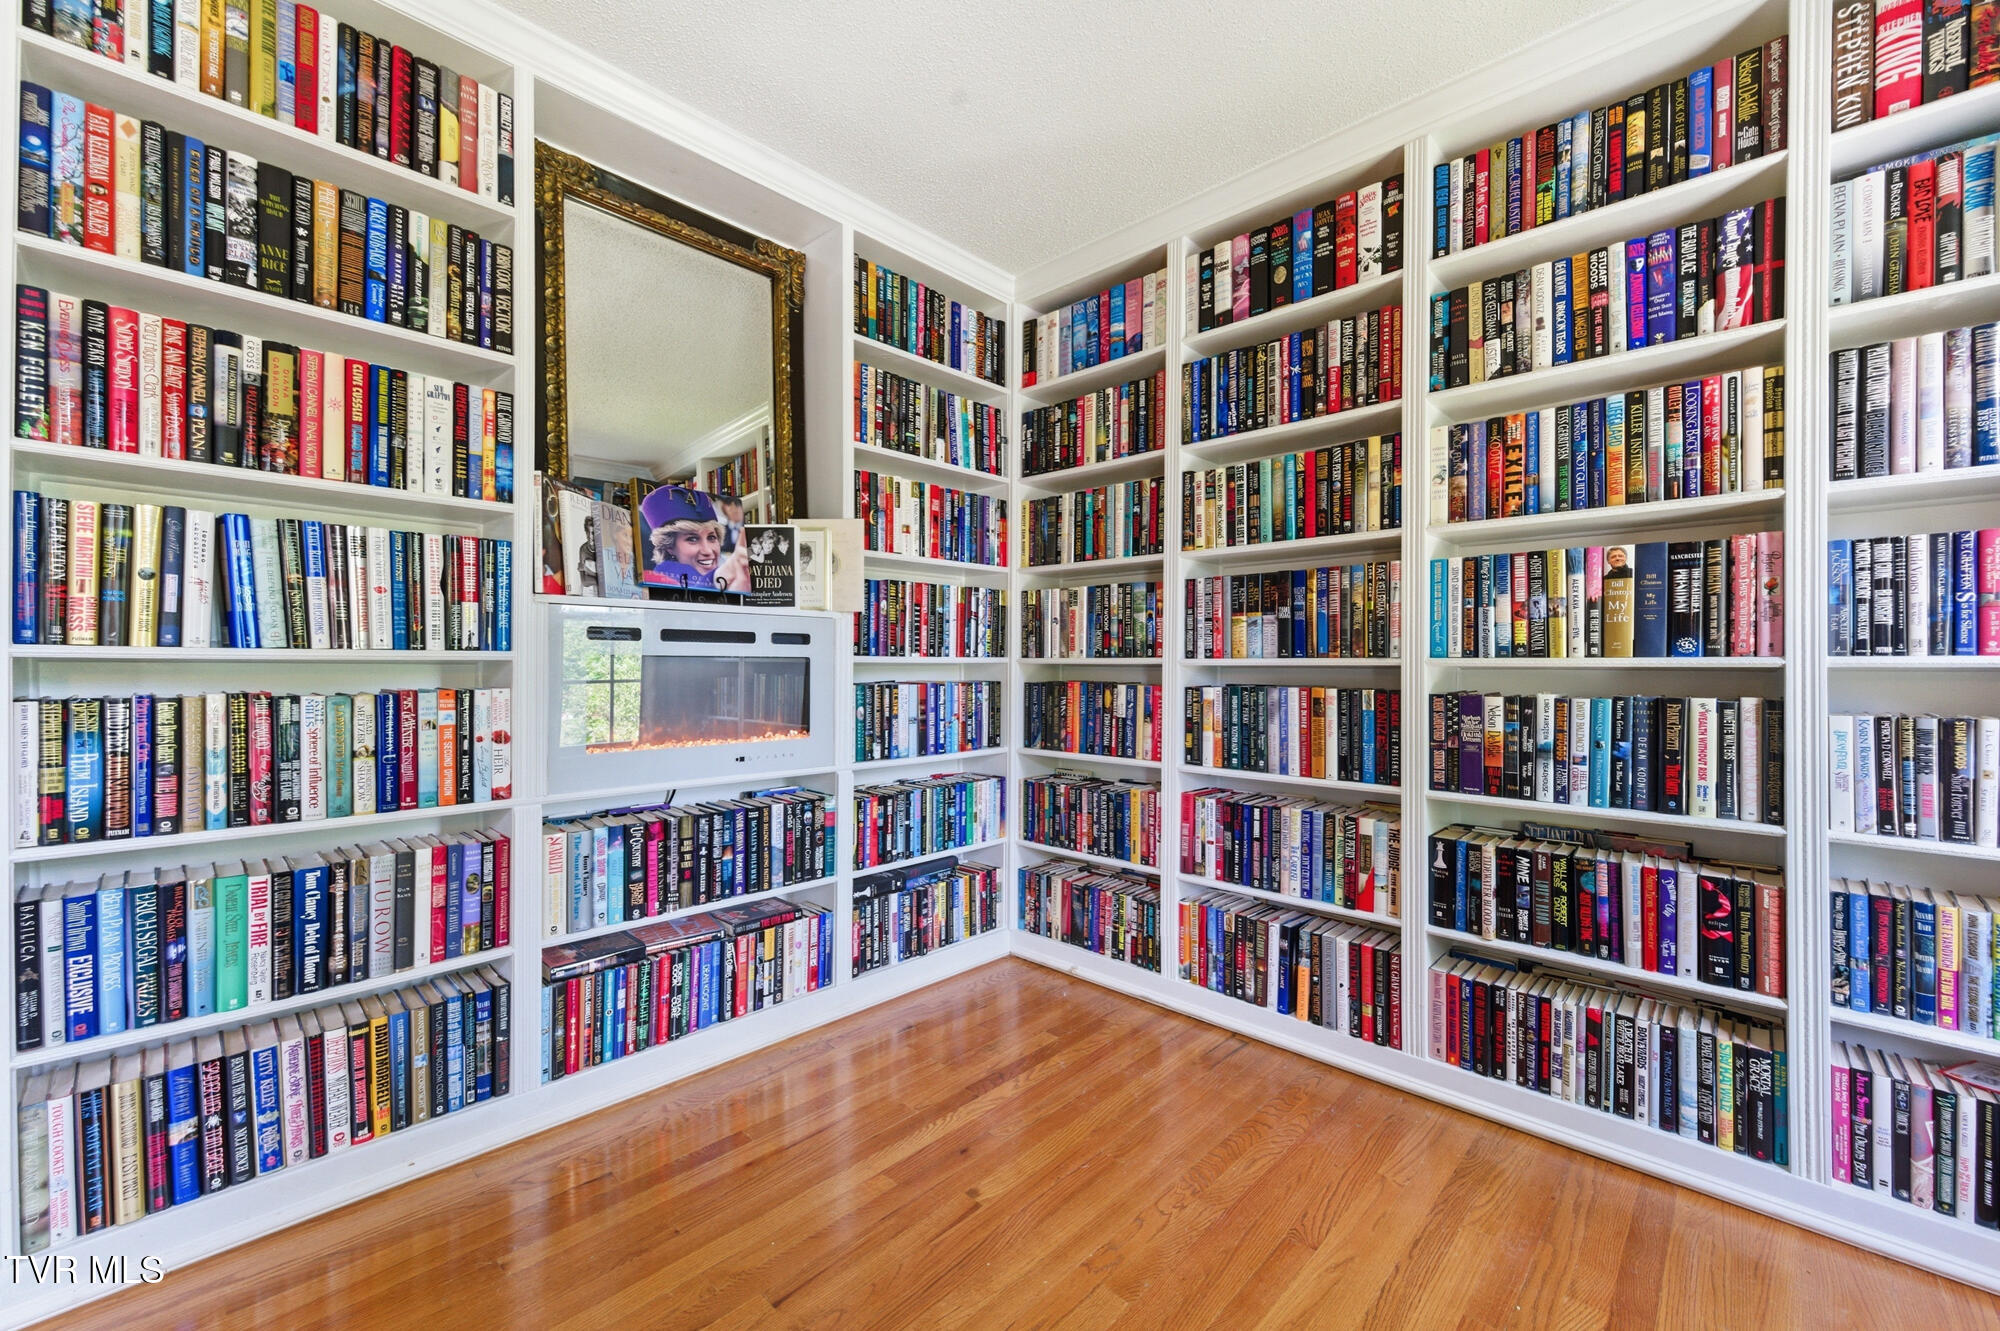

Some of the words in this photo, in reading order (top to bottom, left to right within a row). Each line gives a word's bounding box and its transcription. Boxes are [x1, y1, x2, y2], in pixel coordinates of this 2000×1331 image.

[1878, 11, 1922, 35] STEPHEN
[1836, 2, 1863, 91] STEPHEN
[1874, 22, 1922, 92] KING
[1927, 27, 1946, 75] THINGS
[1944, 16, 1967, 73] NEEDFUL
[1738, 52, 1760, 88] Nelson
[1738, 86, 1759, 123] DeMille
[1836, 92, 1863, 129] KIN
[88, 112, 109, 133] FAYE
[88, 135, 110, 183] KELLERMAN
[295, 181, 312, 200] THE
[1508, 173, 1521, 202] CRUEL
[1891, 170, 1901, 183] THE
[1913, 177, 1932, 198] BAD
[296, 201, 312, 227] ECHO
[1832, 184, 1847, 217] BELVA
[1890, 182, 1904, 220] BROKER
[1913, 197, 1932, 225] LOVE
[88, 198, 109, 238] STALKER
[206, 202, 225, 234] IMPLANT
[369, 202, 388, 229] KAREN
[395, 208, 404, 249] STORMING
[1507, 203, 1522, 235] JUSTICE
[369, 231, 388, 270] ROBARDS
[1832, 218, 1847, 255] PLAIN
[261, 243, 290, 260] ANNE
[496, 246, 513, 269] ROBIN
[261, 259, 288, 274] RICE
[395, 253, 404, 284] HEAVEN
[496, 269, 513, 290] COOK
[1590, 253, 1599, 290] WOODS
[1598, 250, 1608, 288] STUART
[88, 306, 105, 334] ANNE
[496, 294, 512, 335] VECTOR
[1594, 308, 1603, 325] THE
[20, 320, 47, 347] KEN
[1595, 326, 1603, 345] RUN
[87, 337, 105, 368] PERRY
[246, 341, 255, 369] CROSS
[19, 355, 47, 419] FOLLETT
[271, 364, 280, 408] GABALDON
[282, 369, 290, 399] DIANA
[351, 364, 363, 386] CLIVE
[351, 387, 363, 423] CUSSLER
[496, 393, 512, 413] JULIE
[1556, 408, 1569, 425] TESS
[1685, 385, 1701, 429] LOOKING
[191, 419, 207, 450] PLAN
[306, 422, 320, 442] FINAL
[497, 413, 512, 444] GARWOOD
[1606, 400, 1624, 448] LIFEGUARD
[1629, 404, 1644, 436] KILLER
[306, 442, 319, 469] VICTIM
[1489, 436, 1502, 475] KOONTZ
[1556, 424, 1570, 461] GERRITSEN
[1685, 429, 1701, 453] BACK
[1504, 443, 1524, 503] EXILE
[1559, 464, 1569, 477] THE
[1575, 450, 1586, 473] NOT
[1629, 438, 1644, 482] INSTINCT
[1559, 477, 1569, 501] SINNER
[1575, 474, 1586, 501] GUILTY
[49, 500, 67, 524] SUE
[76, 503, 95, 534] STEVE
[49, 525, 67, 582] GRAFTON
[75, 536, 94, 579] MARTINI
[1855, 541, 1872, 572] MORTAL
[755, 577, 782, 589] DIED
[764, 565, 794, 577] DIANA
[1855, 570, 1872, 601] MEMORY
[292, 589, 303, 609] JOHN
[1572, 578, 1580, 594] ALEX
[1673, 568, 1691, 614] PRESIDENT
[69, 596, 84, 632] MASS
[86, 596, 98, 633] CRITICAL
[1572, 594, 1580, 610] KAVA
[1607, 600, 1627, 613] My
[292, 609, 303, 636] GRISHAM
[1604, 613, 1630, 624] Life
[1514, 620, 1527, 647] GONE
[1530, 618, 1545, 651] PARANOIA
[231, 698, 247, 729] SIDNEY
[356, 706, 368, 744] MELTZER
[1487, 704, 1502, 730] Nelson
[1697, 711, 1708, 736] WEALTH
[307, 727, 321, 756] Sphere
[443, 727, 454, 740] THE
[1487, 730, 1503, 758] DeMille
[1858, 718, 1871, 745] KAREN
[1952, 720, 1968, 746] STUART
[231, 732, 247, 774] SHELDON
[308, 757, 322, 767] of
[443, 742, 454, 766] SECOND
[493, 749, 504, 776] HEIR
[1637, 736, 1648, 761] DEAN
[1697, 736, 1708, 765] WITHOUT
[1858, 745, 1872, 780] ROBARDS
[1953, 745, 1968, 770] WOODS
[69, 752, 97, 781] PLUM
[1697, 766, 1709, 782] RISK
[157, 775, 177, 793] THE
[308, 767, 323, 810] Influence
[356, 764, 368, 803] SHADOW
[443, 769, 454, 798] OPINION
[1636, 766, 1648, 800] KOONTZ
[69, 782, 98, 823] ISLAND
[155, 793, 178, 819] JUROR
[627, 825, 645, 837] UP
[1389, 828, 1400, 843] THE
[548, 837, 564, 873] SCARLETT
[629, 837, 645, 867] COUNTRY
[1388, 844, 1400, 872] JUDGE
[304, 870, 321, 891] Tom
[1482, 855, 1493, 898] TIDEWATER
[1515, 855, 1530, 885] MINE
[1553, 860, 1561, 888] BRASS
[1560, 858, 1568, 879] WALL
[250, 878, 269, 911] TRIAL
[1560, 881, 1568, 893] OF
[66, 900, 93, 927] Sandra
[135, 891, 158, 932] ERICH
[253, 913, 265, 922] BY
[300, 890, 321, 921] Clancy
[374, 874, 393, 955] TUROW
[1482, 899, 1493, 927] BLOOD
[1553, 896, 1561, 924] DALEY
[1560, 895, 1568, 928] ROBERT
[19, 905, 36, 963] BASILICA
[250, 922, 269, 950] FIRE
[304, 923, 321, 946] Debt
[1941, 910, 1955, 934] JANET
[66, 927, 93, 953] Brown
[136, 931, 158, 973] SEGAL
[304, 946, 320, 955] of
[1941, 932, 1955, 970] EVANOVICH
[102, 951, 123, 992] PROMISES
[303, 955, 320, 985] Honor
[671, 963, 680, 987] COOK
[675, 962, 684, 986] ROBIN
[1390, 956, 1400, 970] SUE
[68, 954, 94, 1017] EXCLUSIVE
[1390, 970, 1400, 1006] GRAFTON
[374, 1024, 387, 1056] DAVID
[1636, 1025, 1648, 1070] BONEYARDS
[258, 1051, 277, 1079] KITTY
[1747, 1058, 1762, 1093] GRACE
[1759, 1057, 1773, 1098] MORTAL
[259, 1080, 278, 1110] KELLEY
[375, 1057, 391, 1106] MORRELL
[1855, 1071, 1870, 1093] JULIE
[1856, 1092, 1870, 1118] SMITH
[51, 1105, 64, 1137] TOUGH
[53, 1139, 65, 1177] COOKIE
[85, 1122, 101, 1175] MORTAL
[88, 1178, 104, 1213] FEAR
